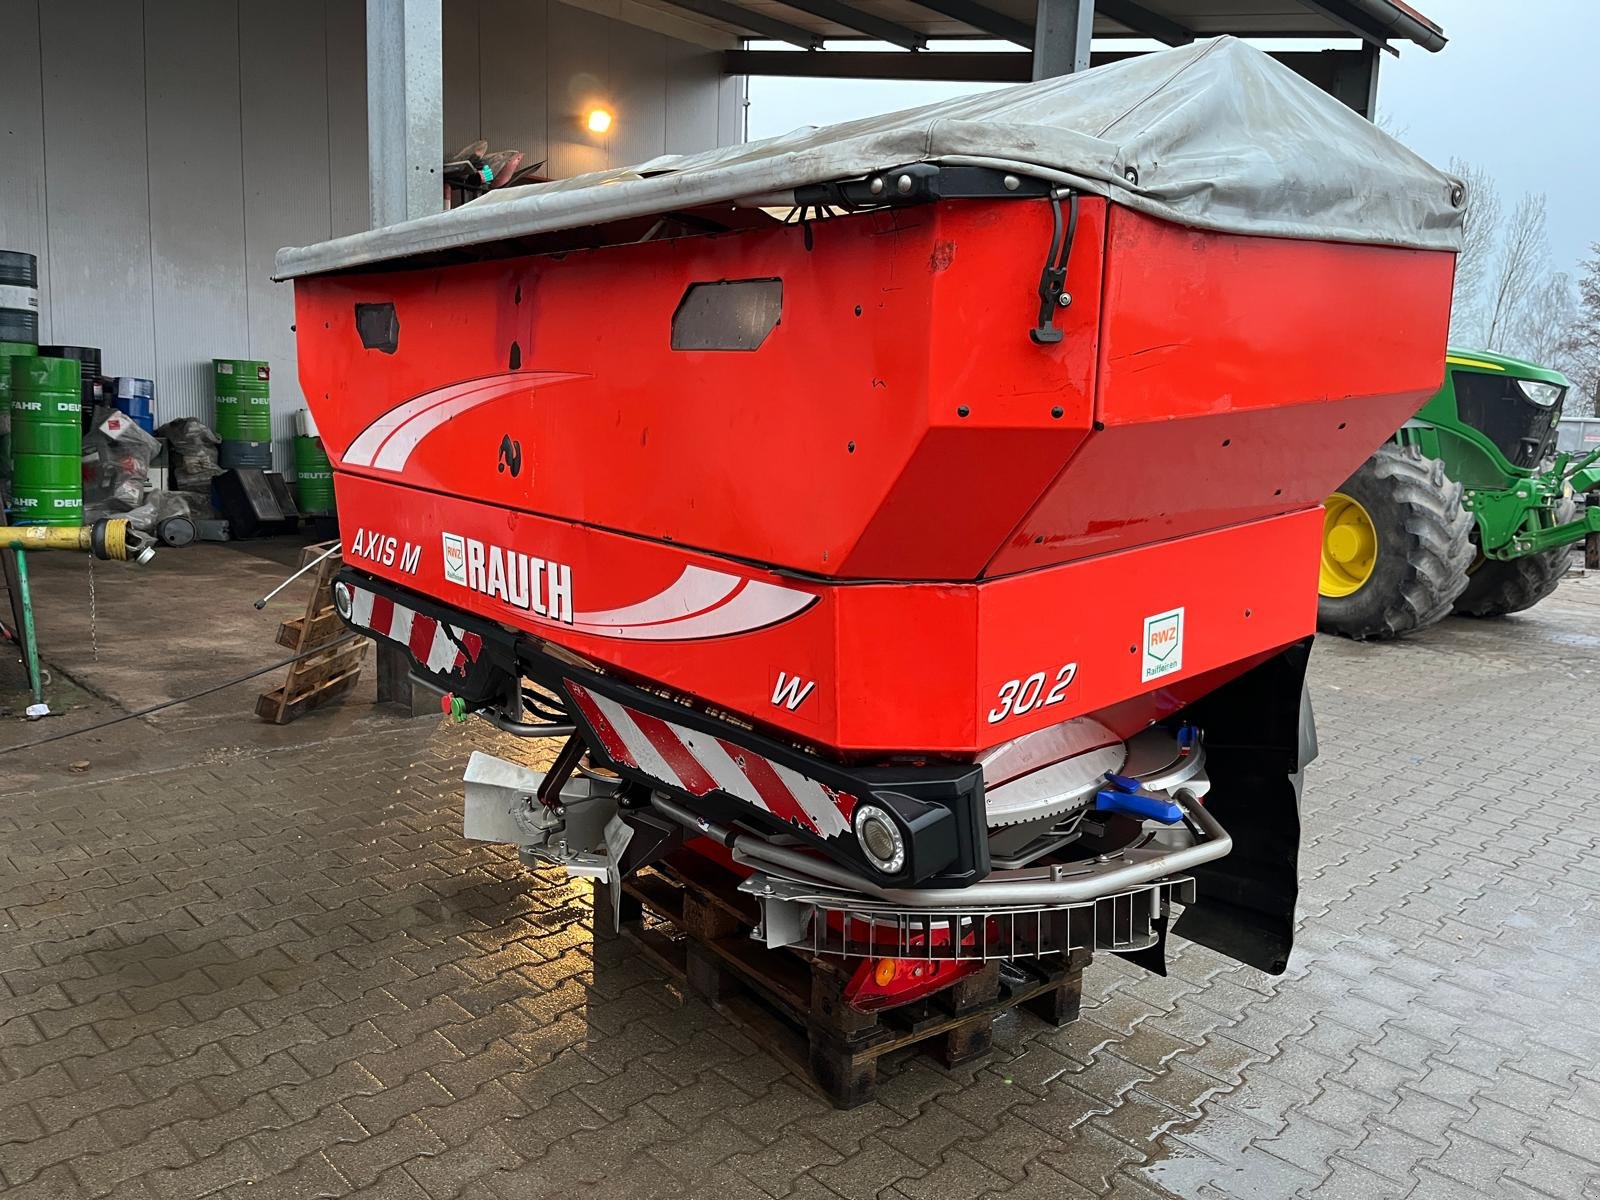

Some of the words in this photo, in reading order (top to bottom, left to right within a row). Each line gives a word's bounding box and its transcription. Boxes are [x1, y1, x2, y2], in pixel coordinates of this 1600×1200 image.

[351, 527, 398, 566] AXIS
[399, 542, 422, 575] M
[466, 537, 574, 625] RAUCH
[1151, 626, 1176, 646] RWZ
[771, 671, 815, 712] W
[986, 662, 1078, 724] 30.2
